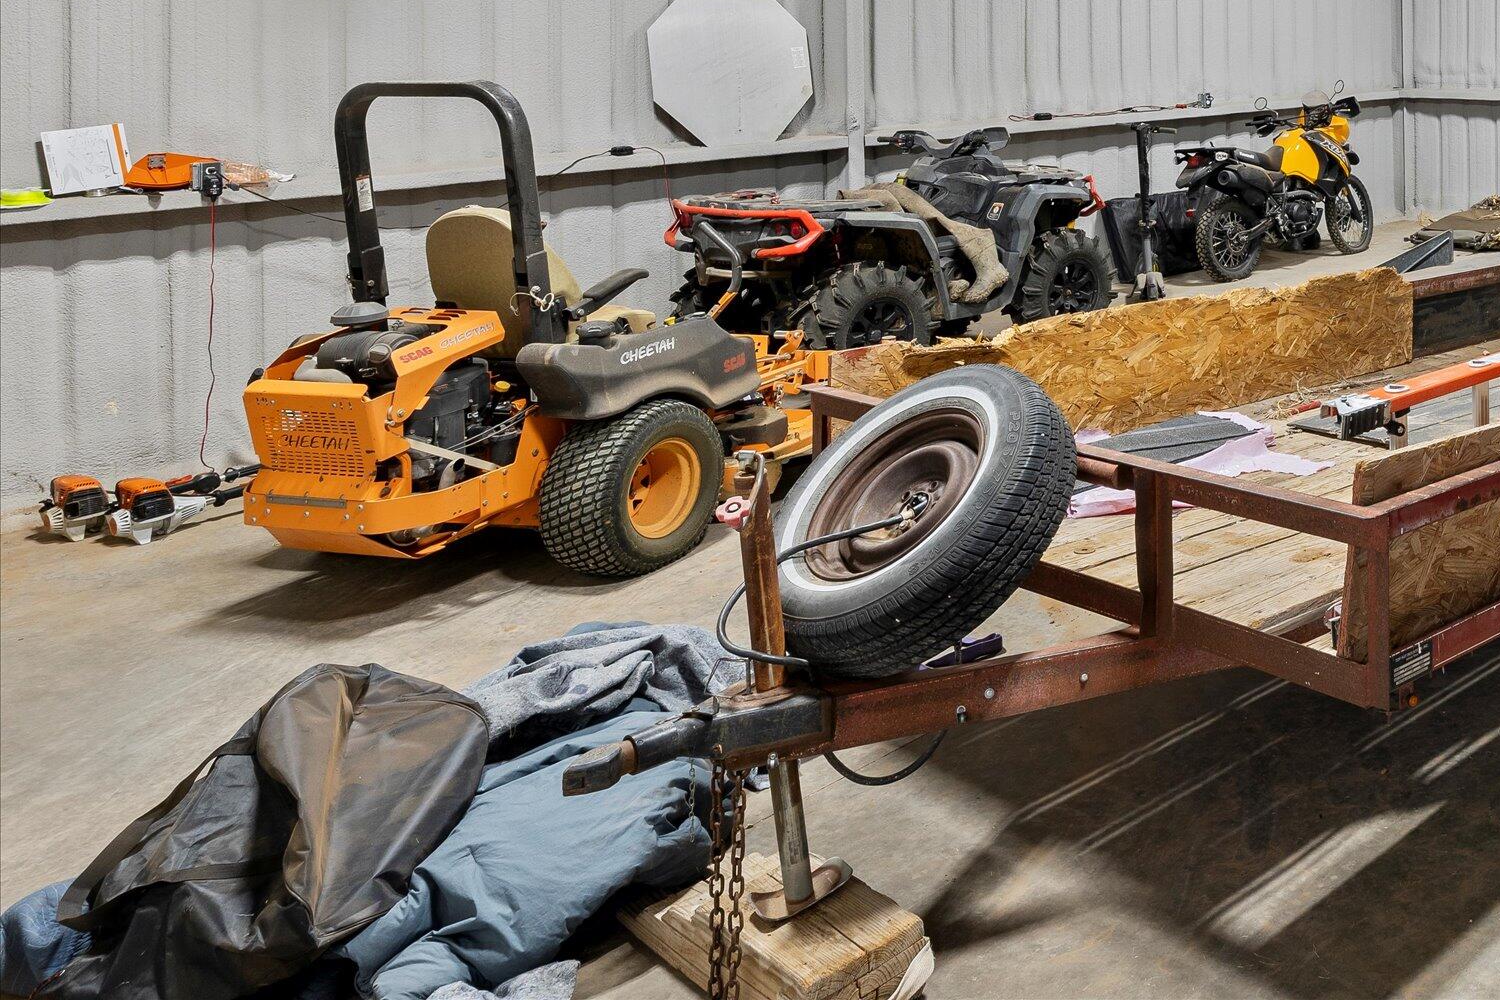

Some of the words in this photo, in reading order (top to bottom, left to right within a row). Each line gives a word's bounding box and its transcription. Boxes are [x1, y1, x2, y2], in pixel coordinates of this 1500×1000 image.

[400, 346, 434, 363] SCAG
[440, 322, 495, 350] CHEETAH
[620, 336, 676, 365] CHEETAH
[281, 434, 350, 450] CHEETAH
